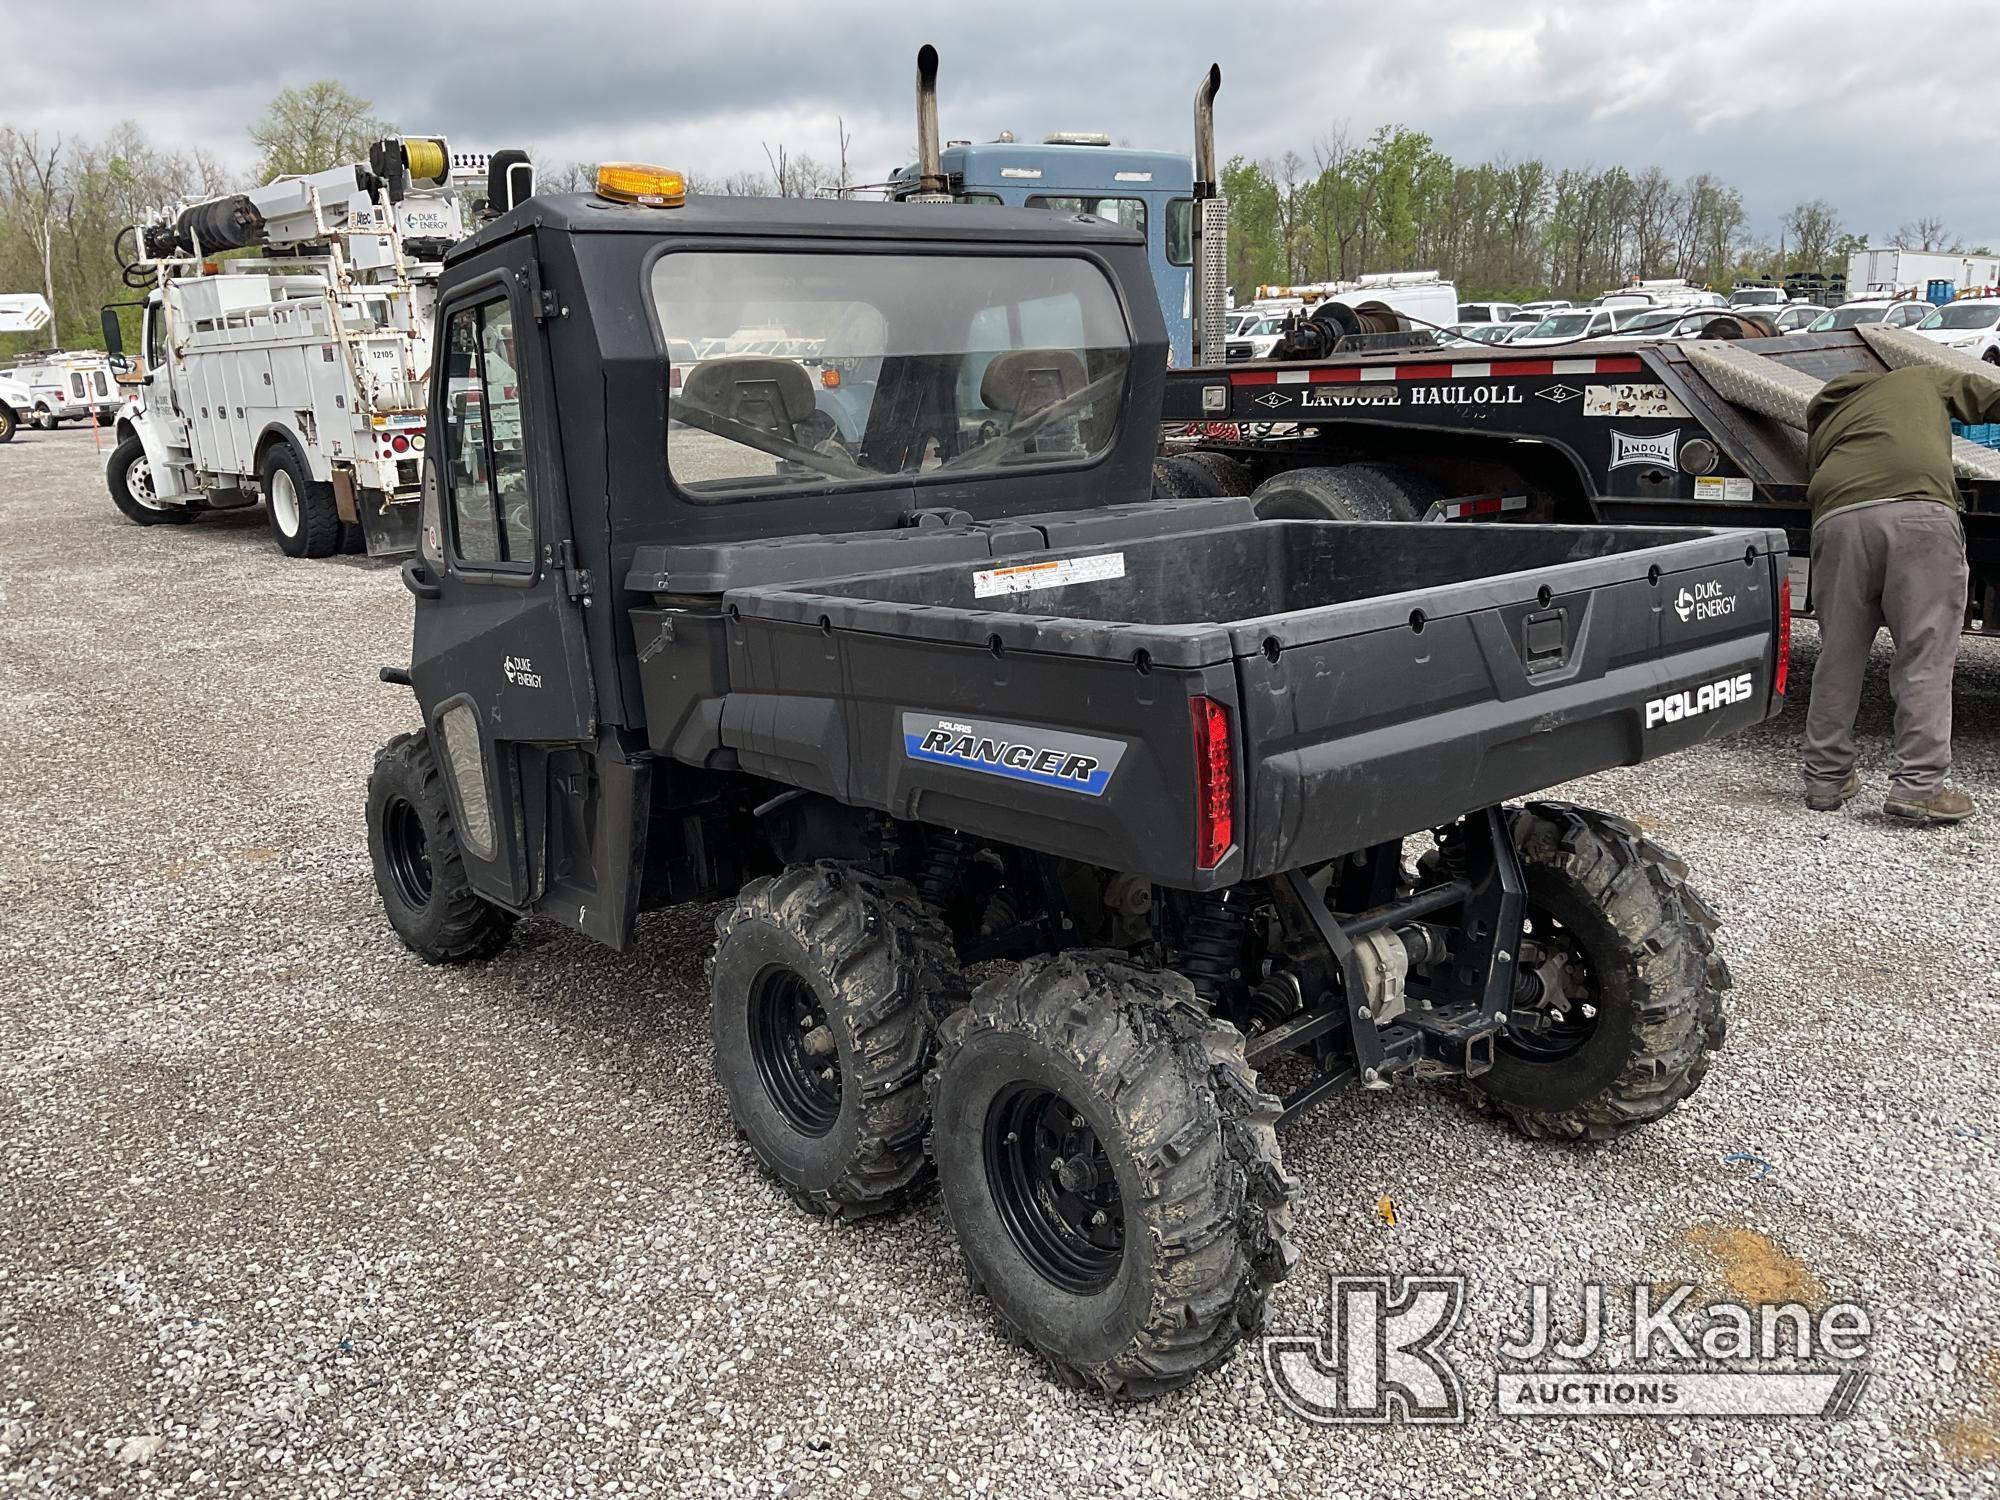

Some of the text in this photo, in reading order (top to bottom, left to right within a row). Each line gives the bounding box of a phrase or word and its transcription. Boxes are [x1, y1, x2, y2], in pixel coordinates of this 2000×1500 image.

[418, 213, 438, 221] DUKE
[372, 350, 394, 359] 12105
[1411, 385, 1523, 405] HAULOLL
[1617, 439, 1670, 462] LANDOLL
[1694, 580, 1723, 600] DUKE
[1696, 595, 1736, 620] ENERGY
[513, 657, 533, 672] DUKE
[516, 672, 542, 688] ENERGY
[1645, 672, 1752, 729] POLARIS
[938, 720, 972, 734] POLARIS
[920, 729, 1099, 782] RANGER
